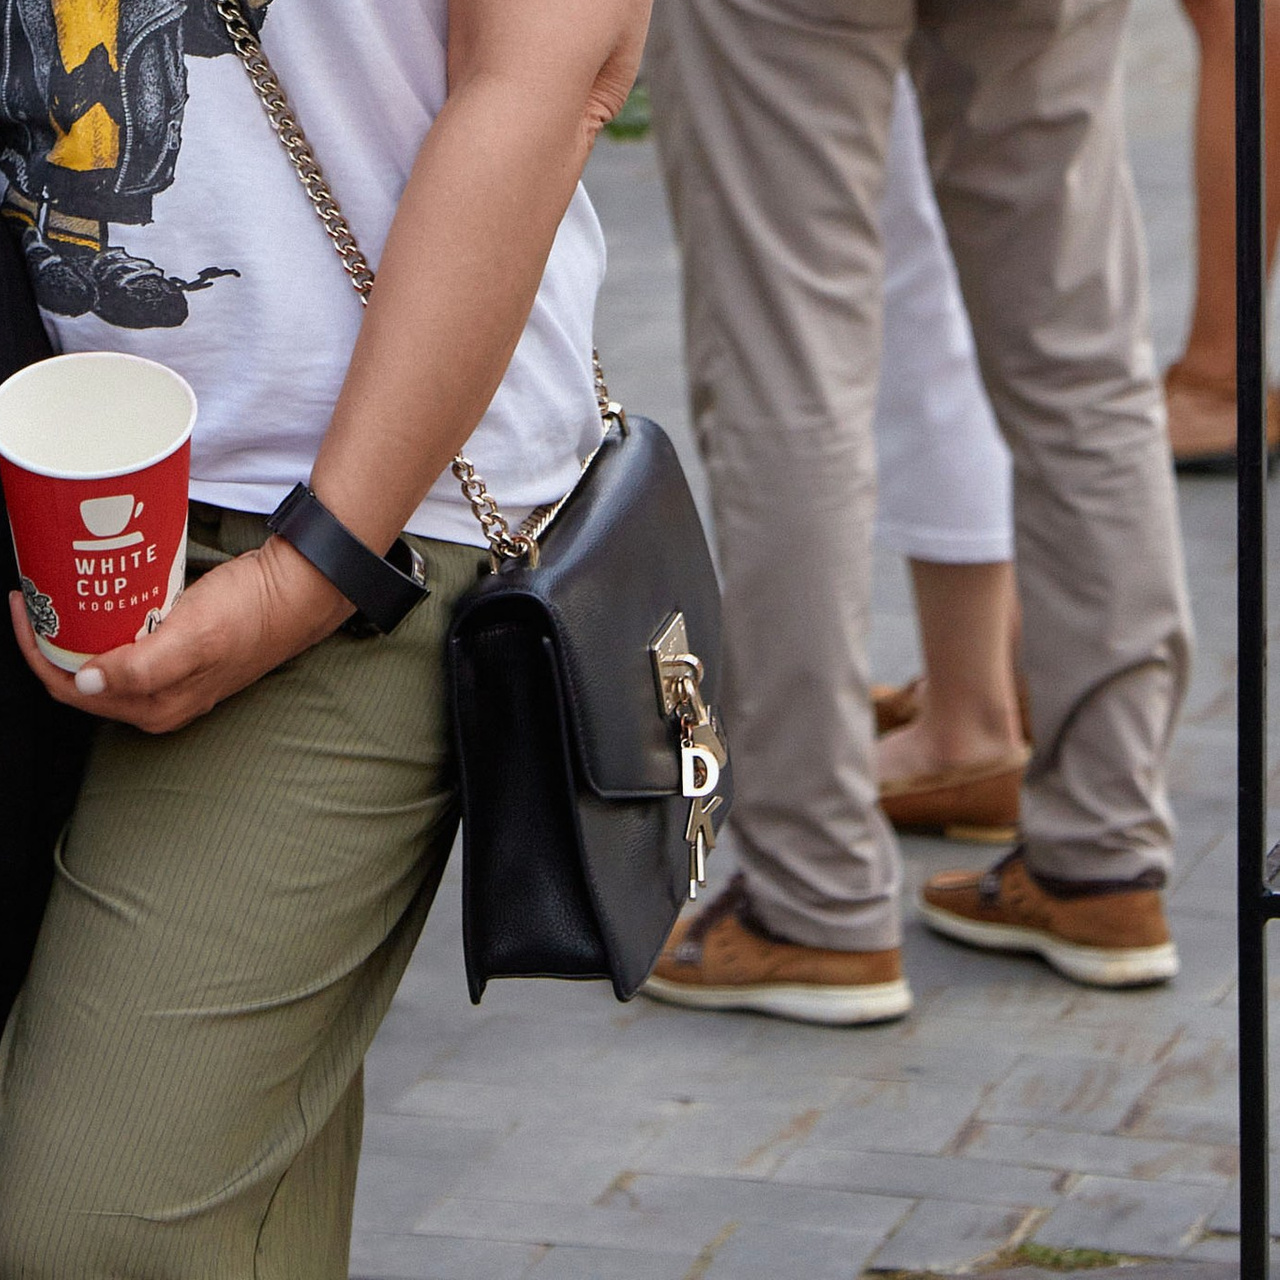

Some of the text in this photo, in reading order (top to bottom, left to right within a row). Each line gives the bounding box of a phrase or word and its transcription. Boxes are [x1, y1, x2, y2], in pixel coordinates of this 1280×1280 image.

[74, 543, 157, 576] WHITE
[76, 577, 128, 597] CUP
[78, 585, 160, 612] КОФЕЙНЯ
